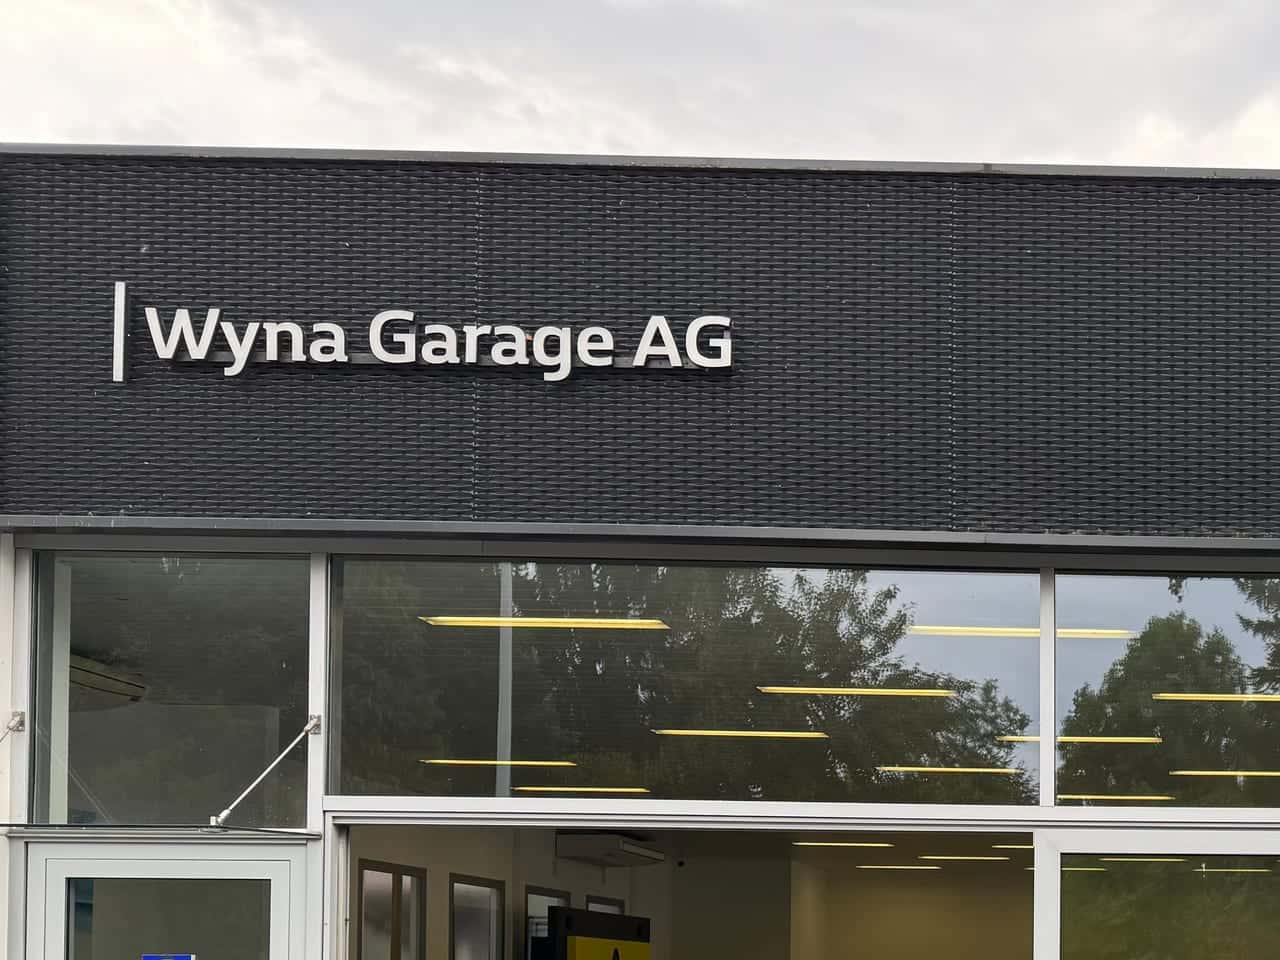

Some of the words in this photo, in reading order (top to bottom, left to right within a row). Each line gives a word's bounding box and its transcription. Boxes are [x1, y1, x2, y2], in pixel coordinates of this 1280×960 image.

[144, 307, 348, 376] Wyna
[369, 309, 613, 381] Garage
[633, 315, 732, 368] AG
